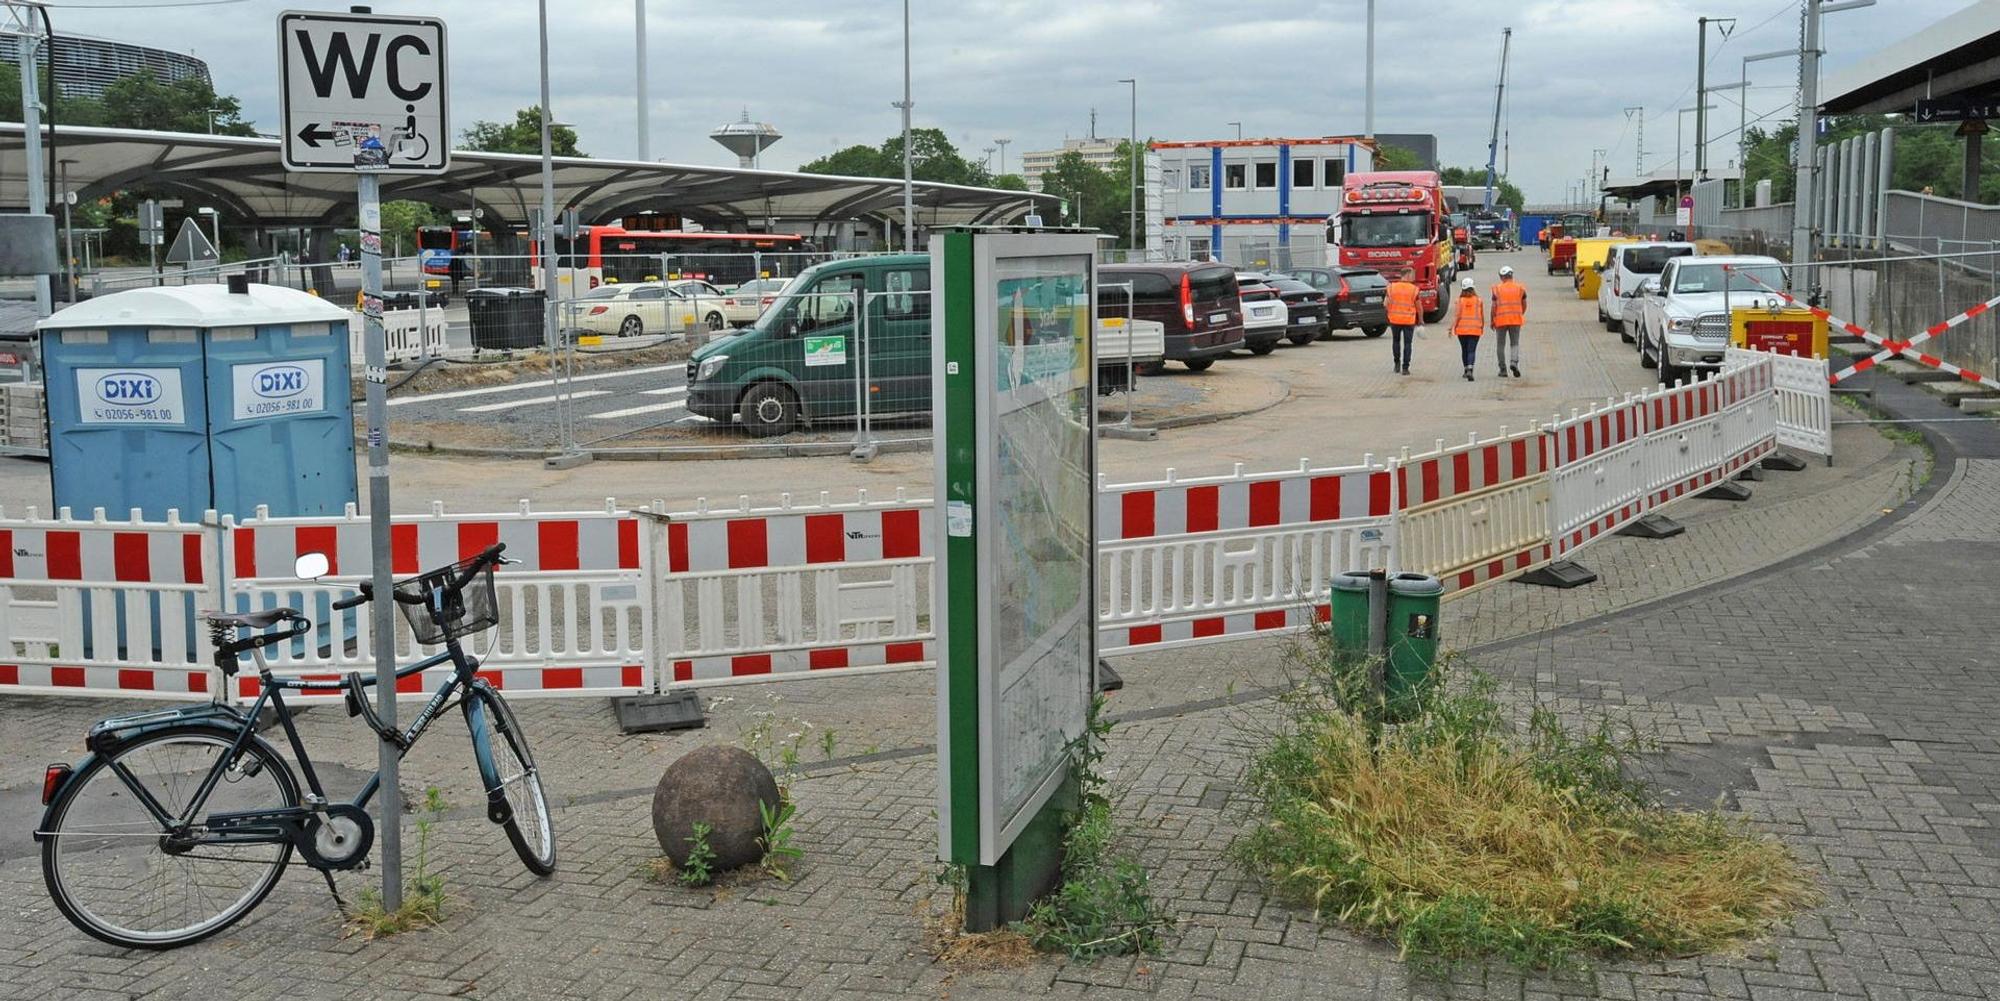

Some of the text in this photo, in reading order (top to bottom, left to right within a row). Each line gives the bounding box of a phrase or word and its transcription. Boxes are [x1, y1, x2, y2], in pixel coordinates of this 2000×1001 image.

[296, 30, 432, 101] WC
[302, 398, 313, 410] 00
[159, 409, 172, 420] 00
